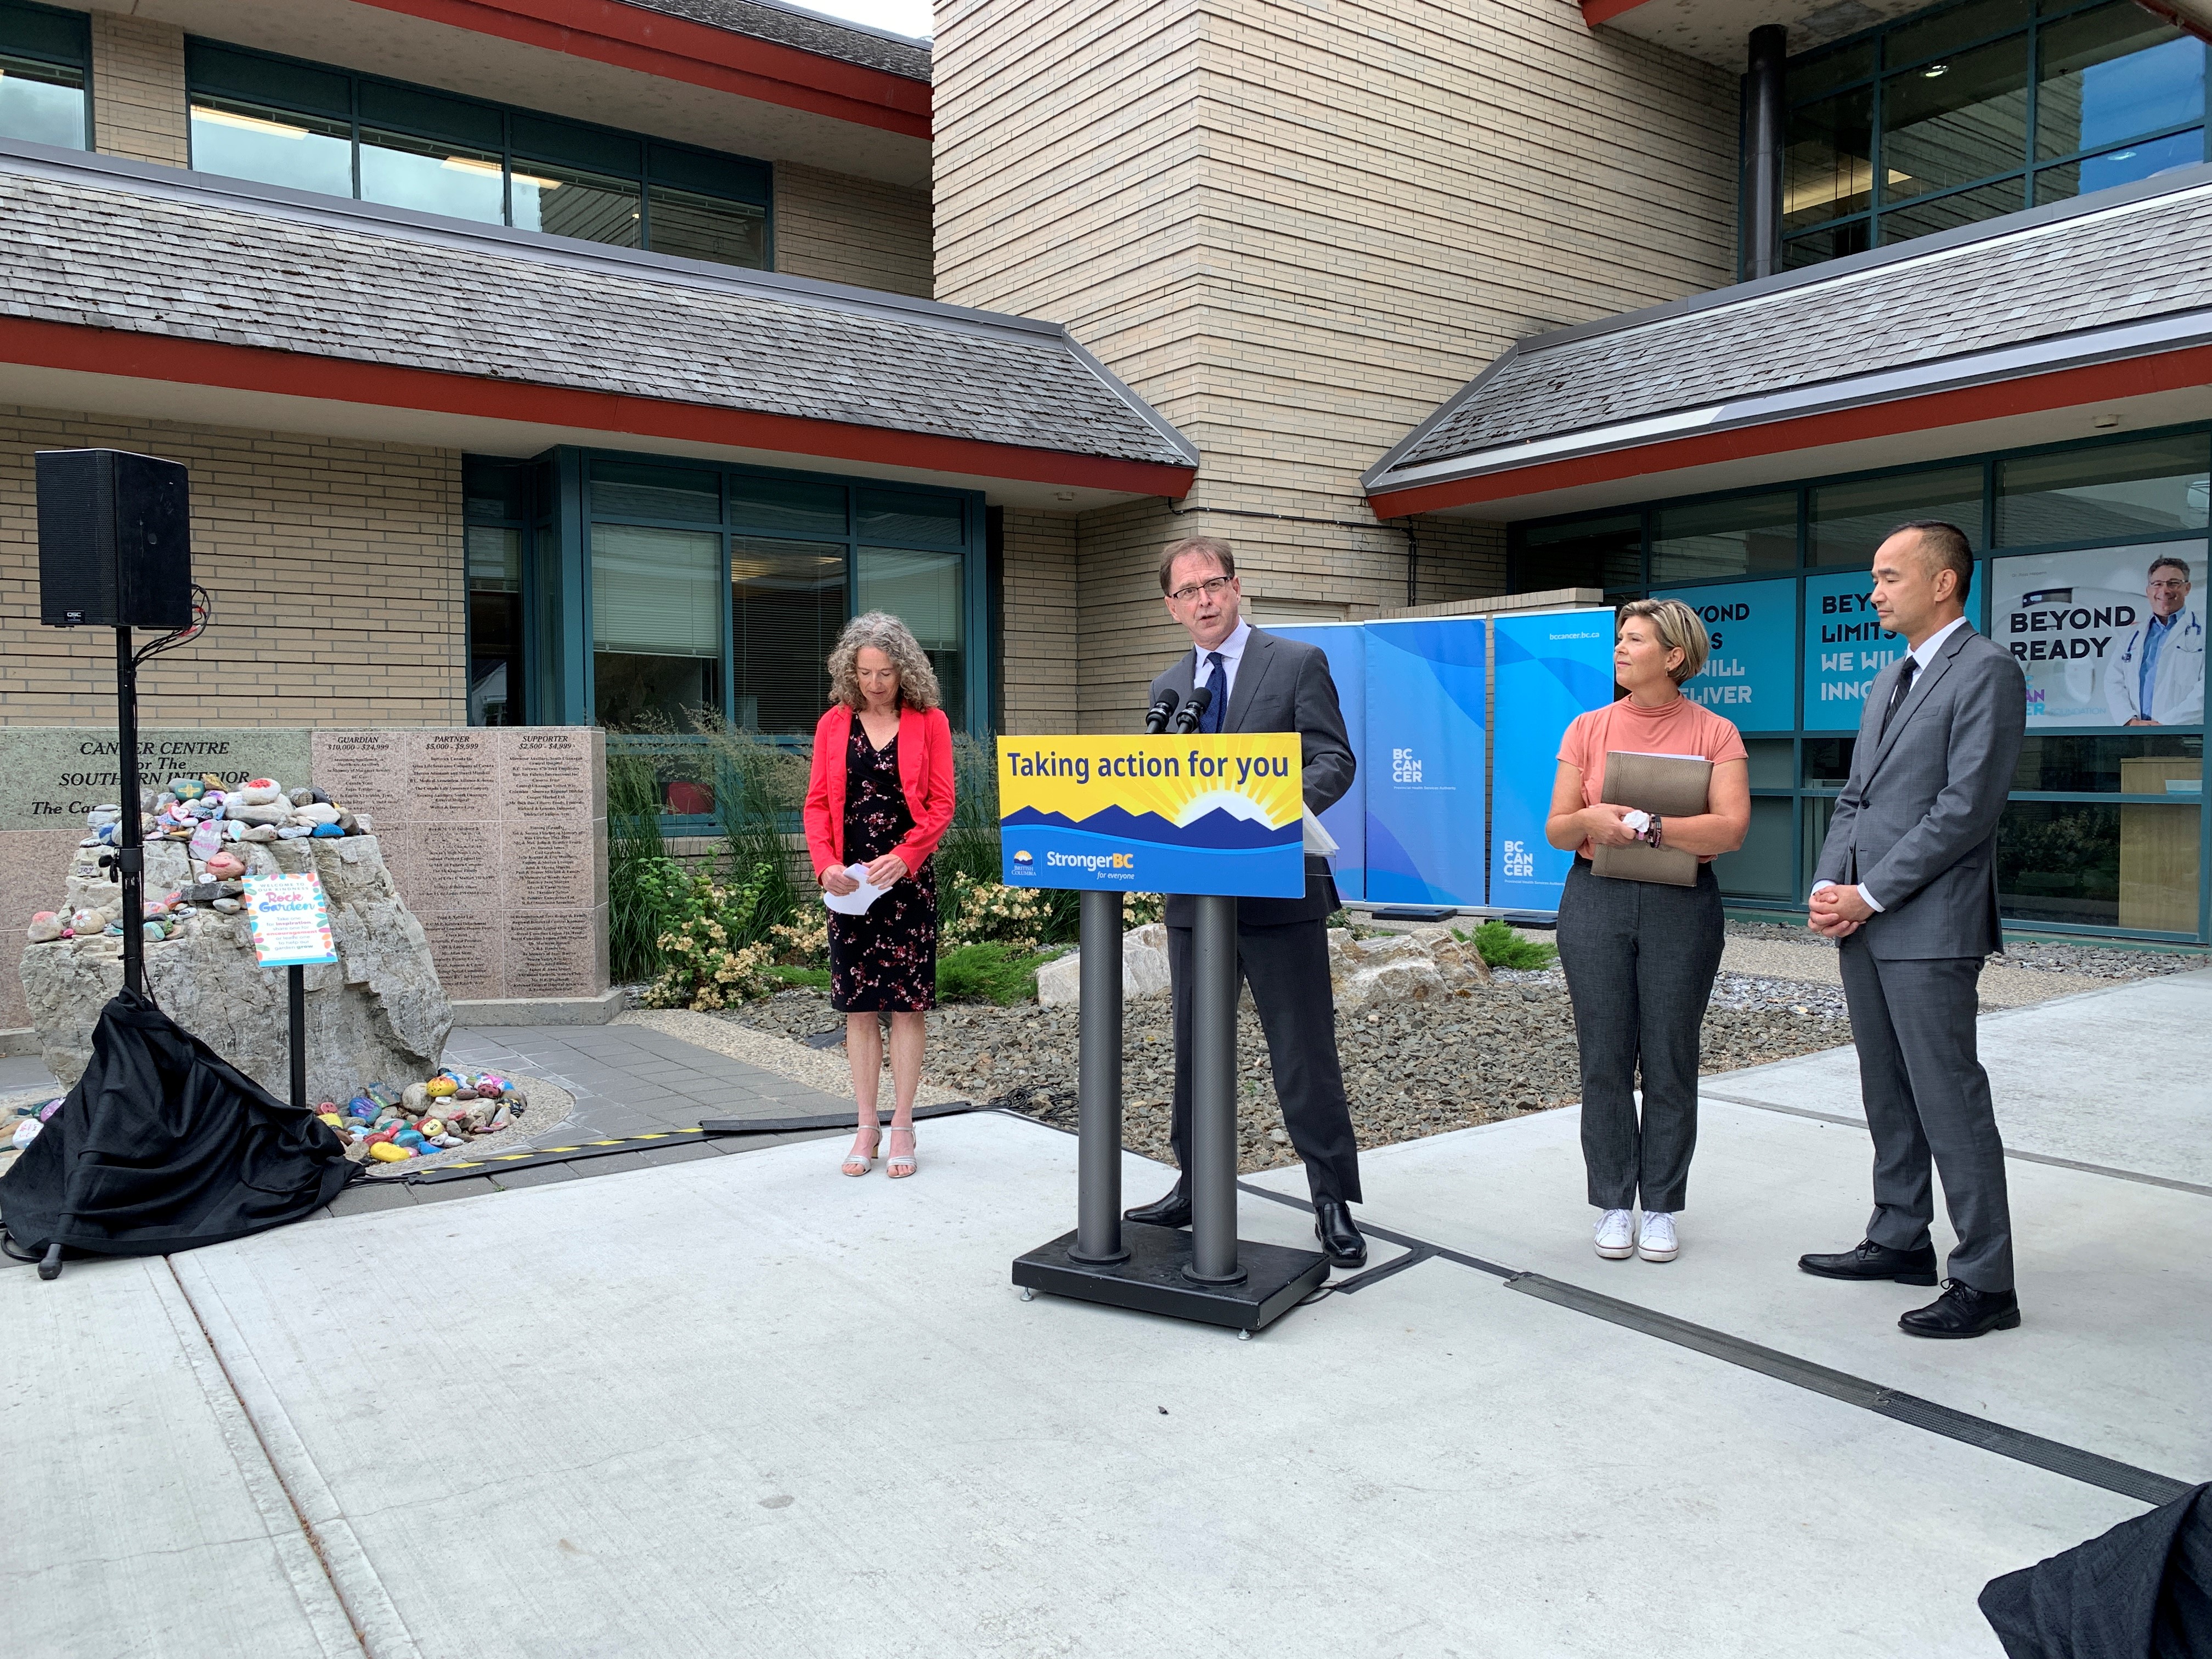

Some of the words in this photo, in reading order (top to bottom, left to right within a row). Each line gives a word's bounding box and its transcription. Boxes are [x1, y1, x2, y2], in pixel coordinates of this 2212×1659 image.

[1822, 592, 1878, 614] BEY
[1692, 603, 1750, 623] YOND
[2011, 606, 2136, 633] BEYOND
[1549, 631, 1600, 640] bccancer.bc.ca
[2010, 636, 2112, 661] READY
[1821, 652, 1854, 672] WE
[1861, 650, 1894, 671] WI
[1678, 686, 1752, 704] LIVER
[2026, 689, 2045, 702] AN
[2027, 703, 2045, 715] ER
[80, 742, 155, 754] CANER
[160, 742, 230, 754] CENTRE
[1393, 748, 1413, 760] BC
[157, 758, 186, 770] The
[1007, 751, 1089, 784] Taking
[1098, 751, 1179, 777] action
[1188, 751, 1228, 777] for
[1235, 757, 1288, 785] you
[1392, 760, 1421, 771] CAN
[59, 772, 162, 785] SOUTHRN
[166, 772, 249, 784] INTIOR
[1392, 771, 1423, 782] CER
[32, 802, 62, 814] The
[1504, 840, 1524, 853] BC
[1047, 851, 1133, 871] StrongerBC
[1504, 853, 1533, 865] CAN
[1504, 864, 1533, 877] CER
[266, 891, 303, 902] Rock
[259, 901, 314, 912] Garden
